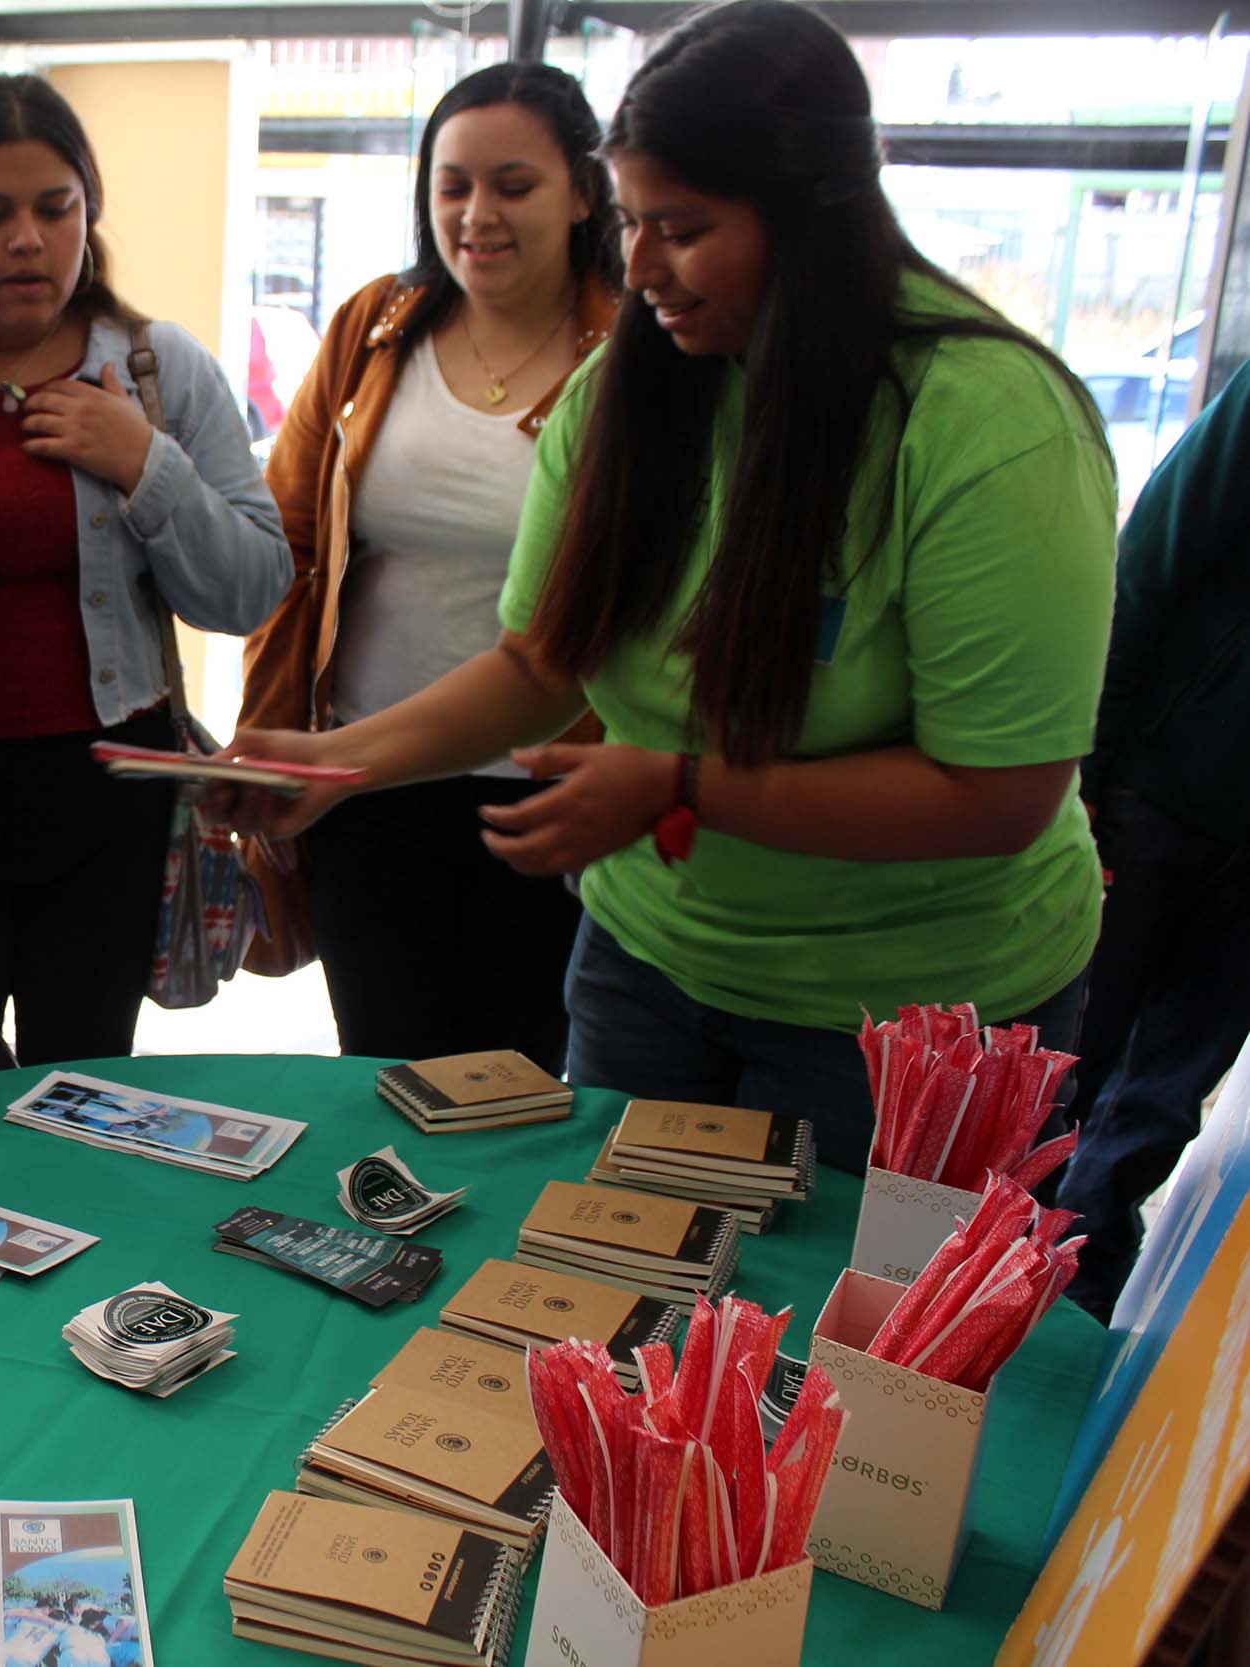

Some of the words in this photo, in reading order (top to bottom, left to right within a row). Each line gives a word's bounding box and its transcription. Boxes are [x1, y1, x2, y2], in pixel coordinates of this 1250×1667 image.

[369, 1188, 405, 1211] DAE
[514, 1284, 542, 1310] SANTO
[134, 1310, 187, 1336] DAE
[446, 1359, 477, 1389] SANTO
[782, 1369, 807, 1402] DAE
[401, 1416, 438, 1448] SANTO
